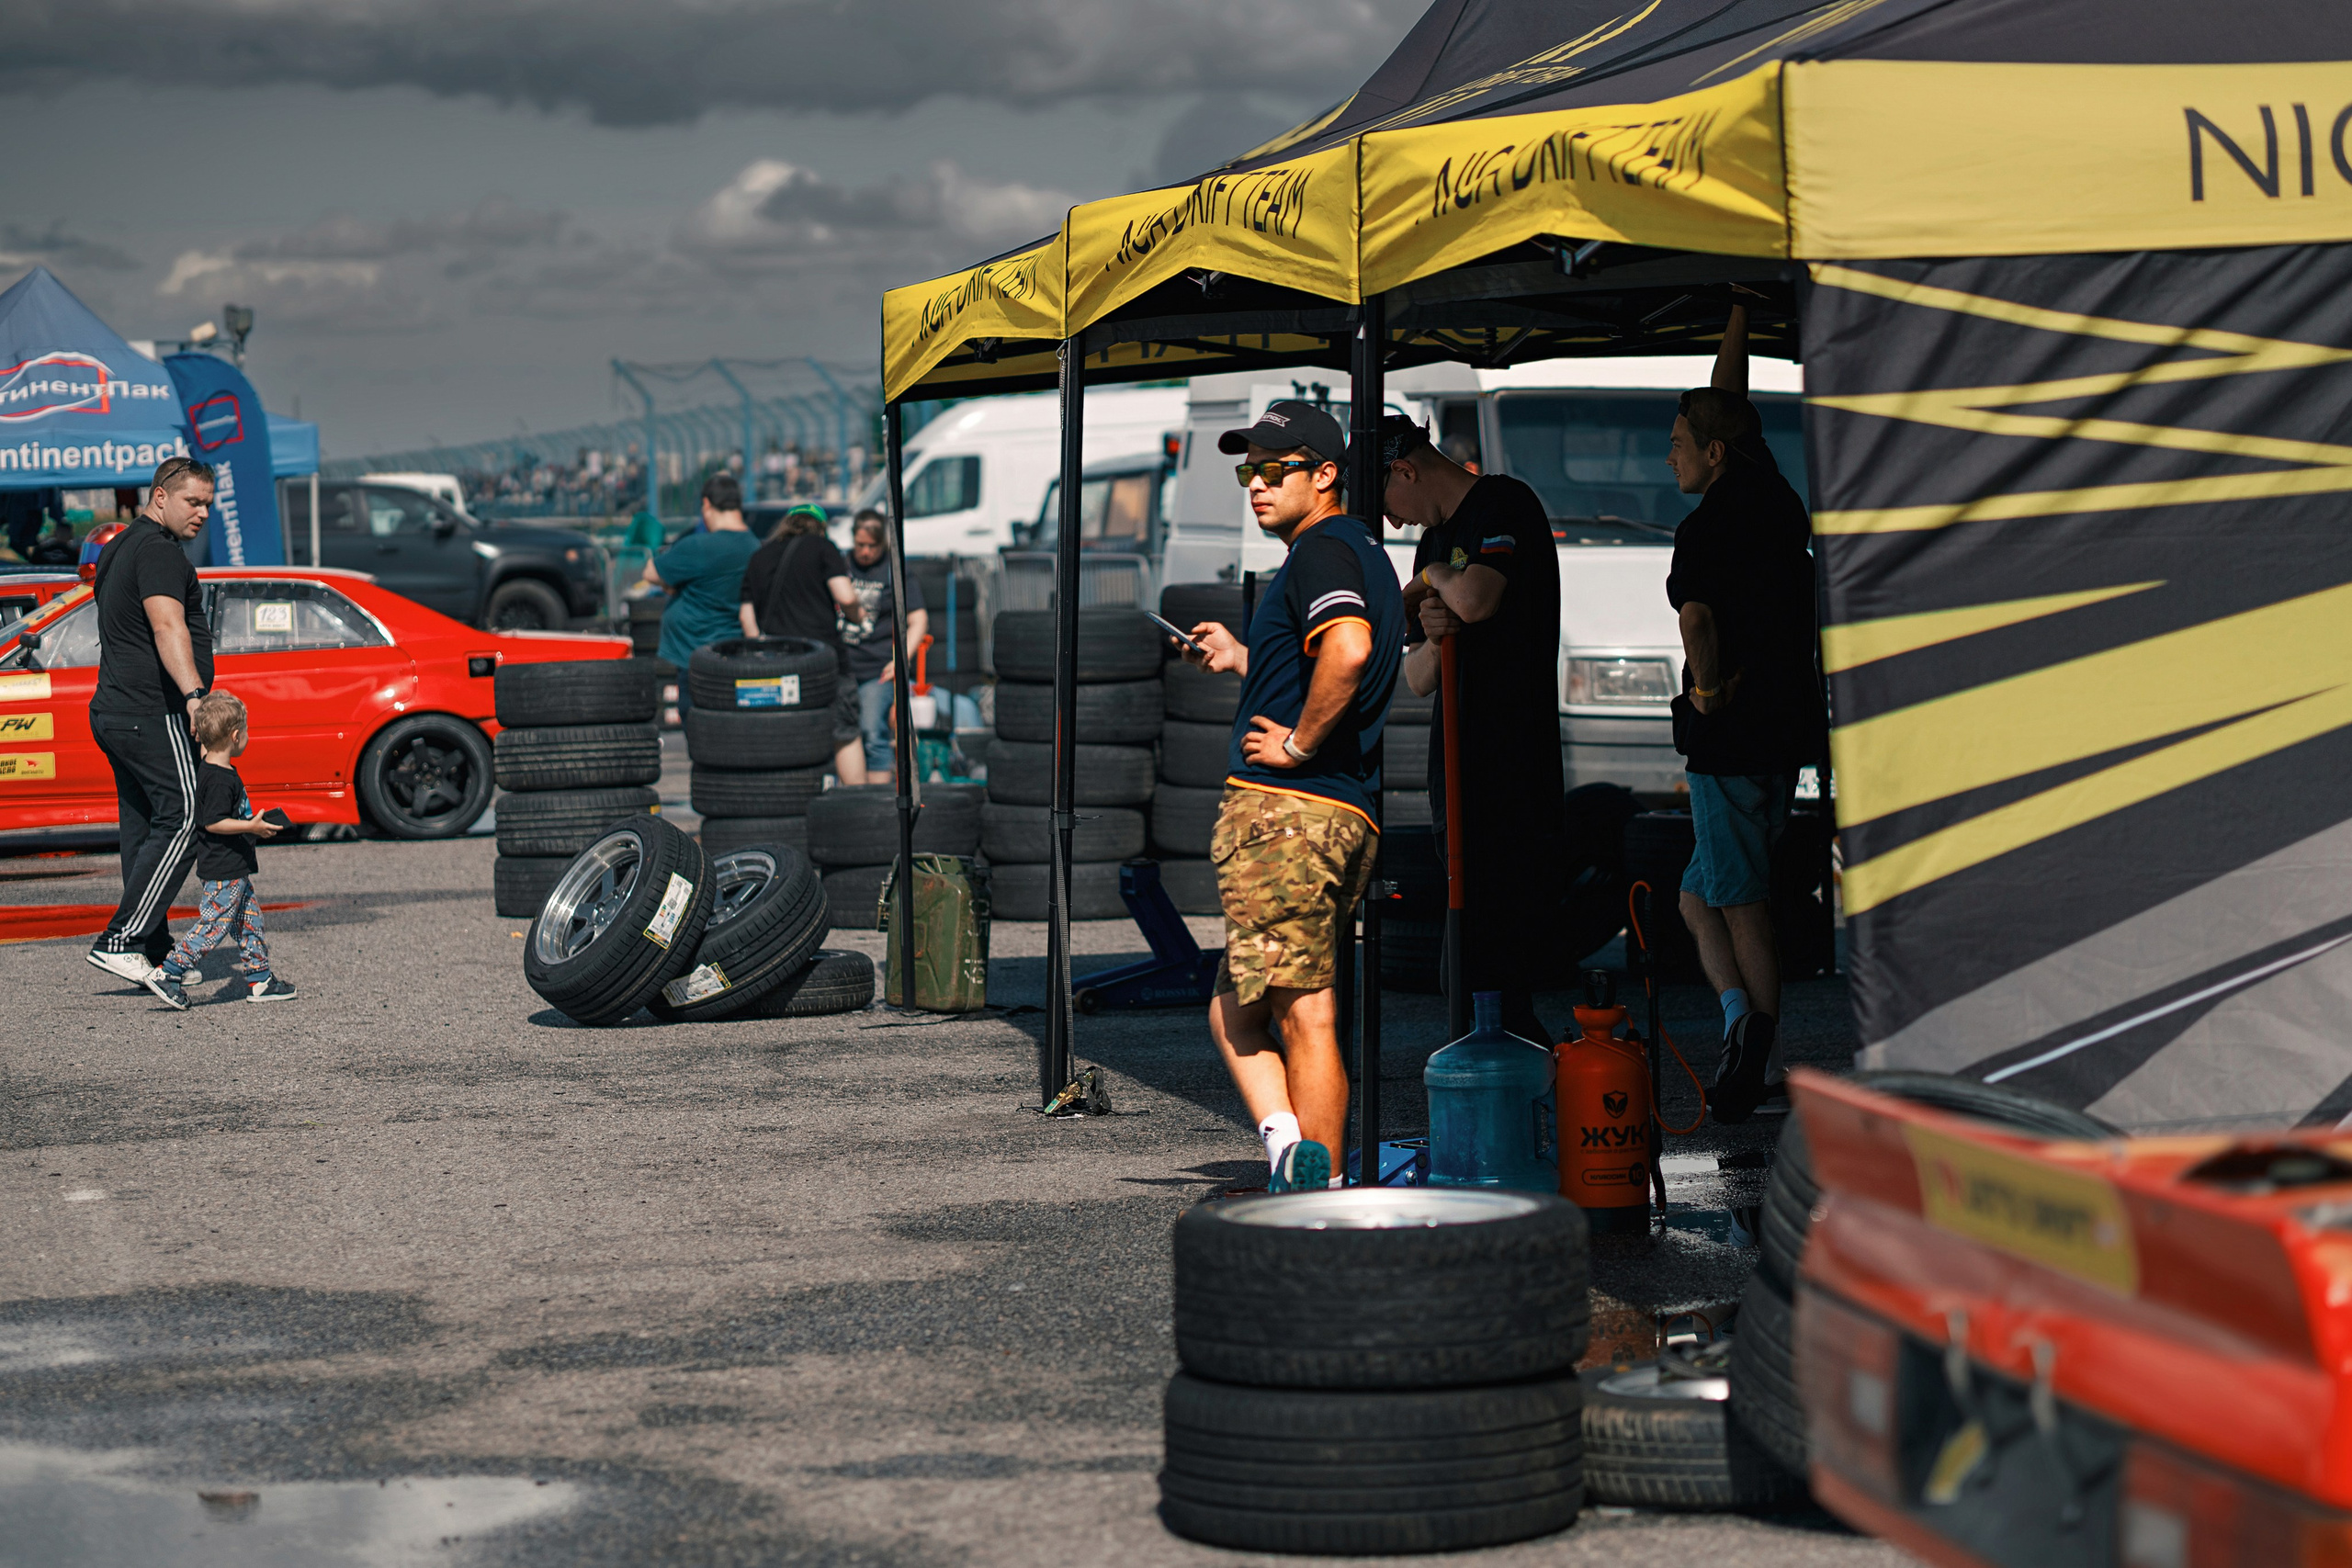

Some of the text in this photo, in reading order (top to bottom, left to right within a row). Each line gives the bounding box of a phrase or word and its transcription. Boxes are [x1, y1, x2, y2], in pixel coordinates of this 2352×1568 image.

[2183, 102, 2352, 201] NI
[259, 606, 288, 623] 123
[1580, 1122, 1646, 1147] ЖУК
